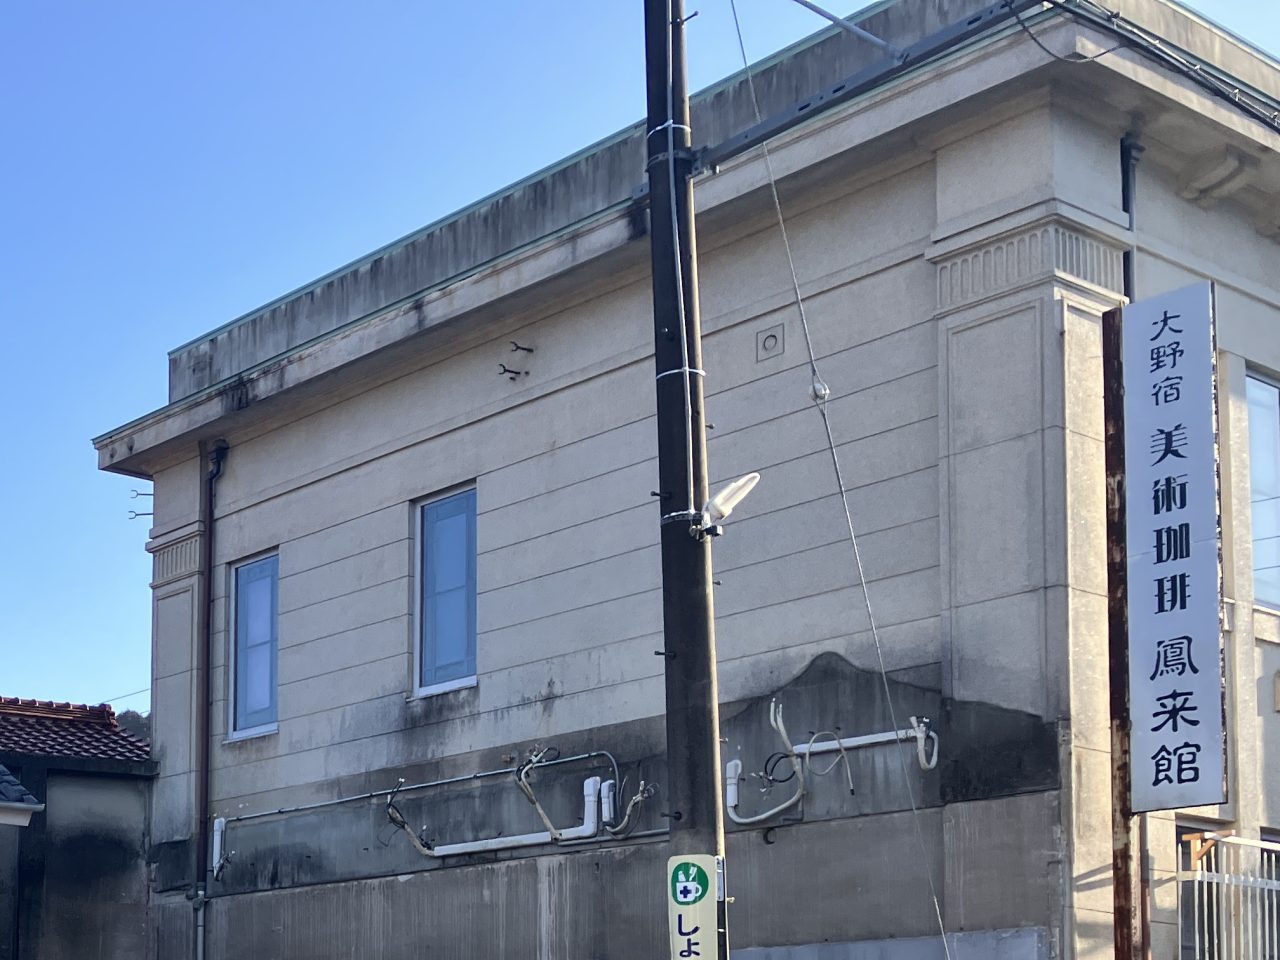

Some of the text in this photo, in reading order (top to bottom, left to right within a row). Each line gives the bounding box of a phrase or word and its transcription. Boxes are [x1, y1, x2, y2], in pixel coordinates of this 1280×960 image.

[1150, 310, 1201, 787] 大野宿 美術珈琲 鳳来館
